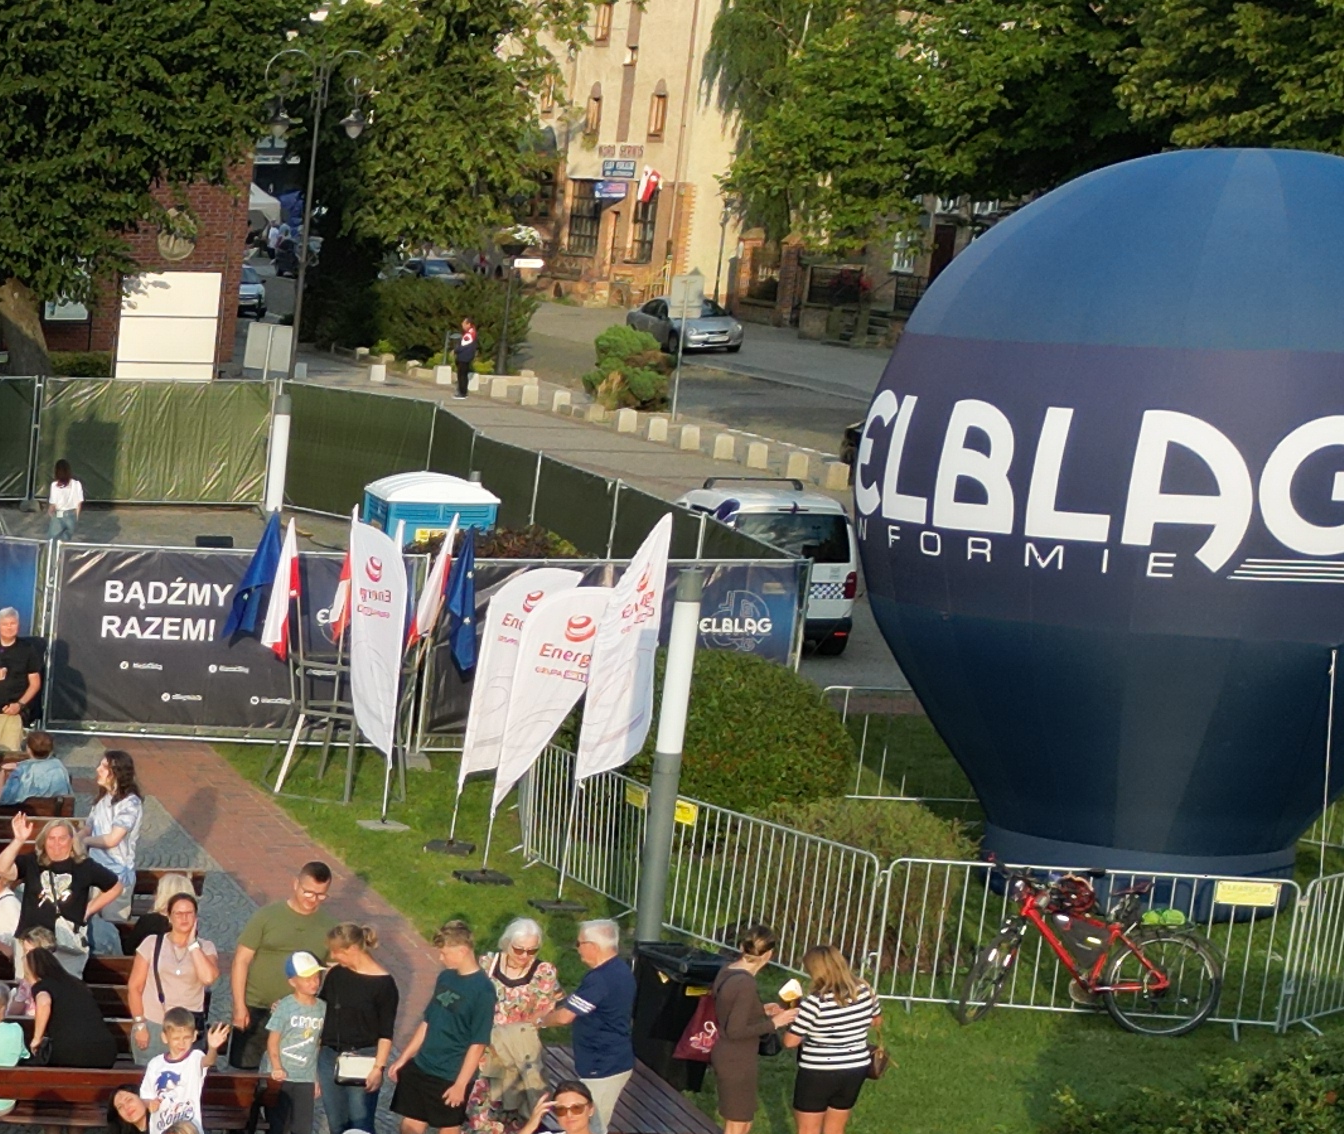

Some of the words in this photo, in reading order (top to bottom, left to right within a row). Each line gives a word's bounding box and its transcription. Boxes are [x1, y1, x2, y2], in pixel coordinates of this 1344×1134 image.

[887, 525, 1179, 578] FORMIE
[103, 577, 234, 610] BĄDŹMY
[100, 615, 216, 642] RAZEM!
